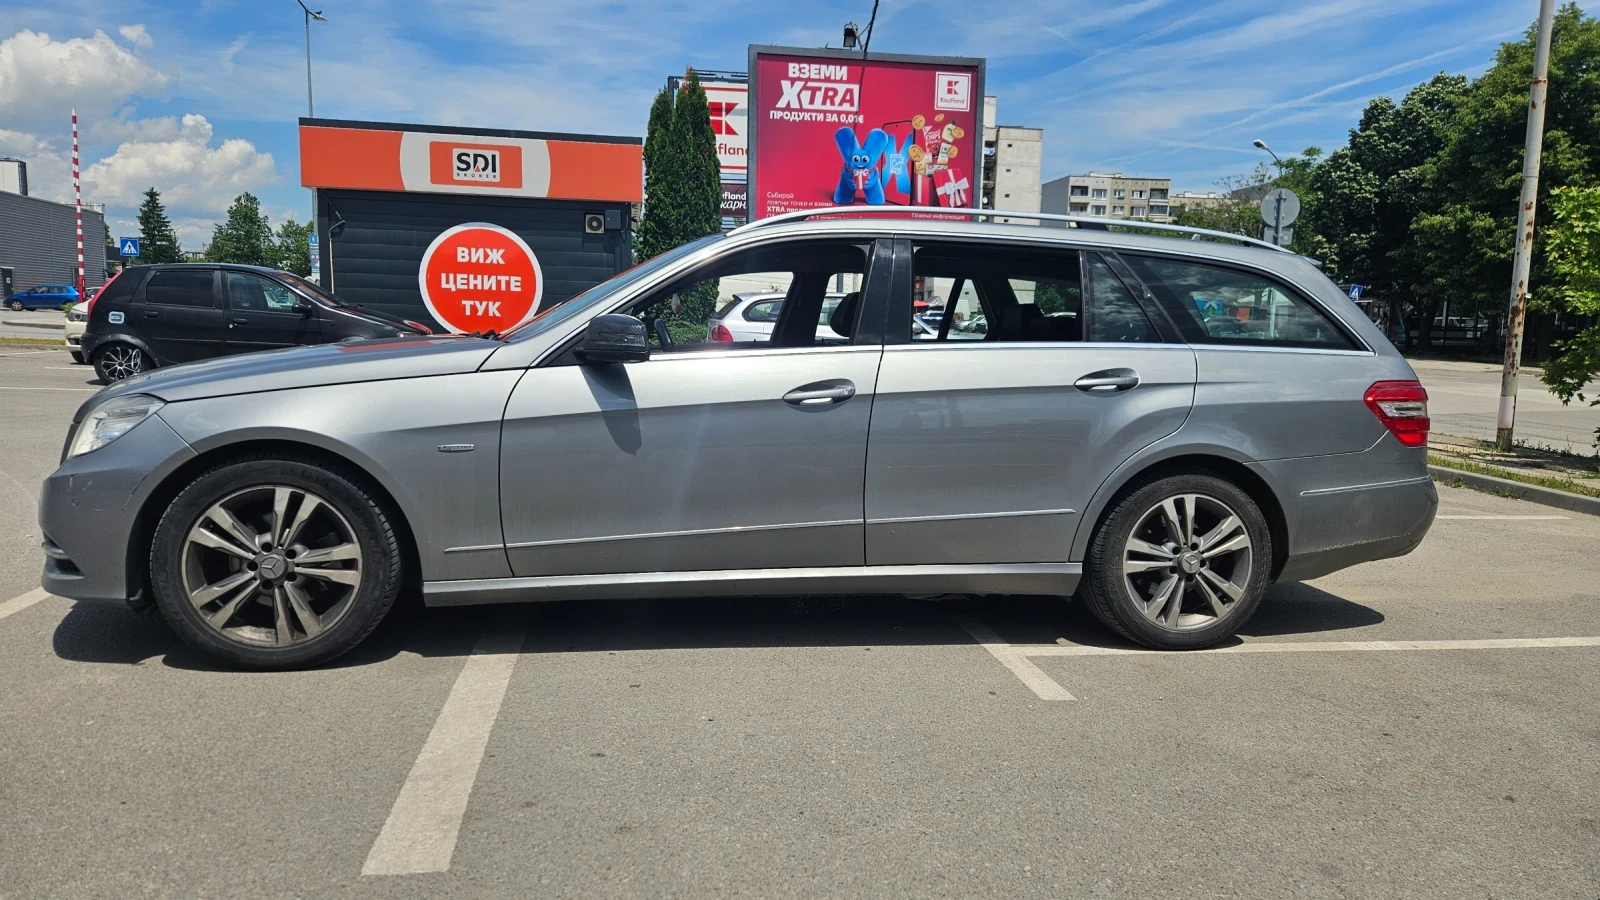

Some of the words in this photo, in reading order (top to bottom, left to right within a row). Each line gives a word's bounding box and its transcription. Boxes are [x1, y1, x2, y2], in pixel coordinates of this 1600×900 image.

[788, 62, 848, 80] ВЗЕМИ
[775, 80, 860, 111] XTRA
[939, 97, 965, 105] Kaufland
[769, 110, 824, 122] ПРОДУКТИ
[825, 113, 838, 122] ЗА
[840, 114, 864, 124] 0,01€
[715, 142, 748, 156] flan
[456, 152, 497, 173] SDI
[722, 191, 747, 201] fland
[766, 191, 794, 199] Събирай
[720, 200, 747, 211] карн
[456, 246, 506, 264] ВИЖ
[441, 273, 522, 291] ЦЕНИТЕ
[461, 300, 502, 316] ТУК
